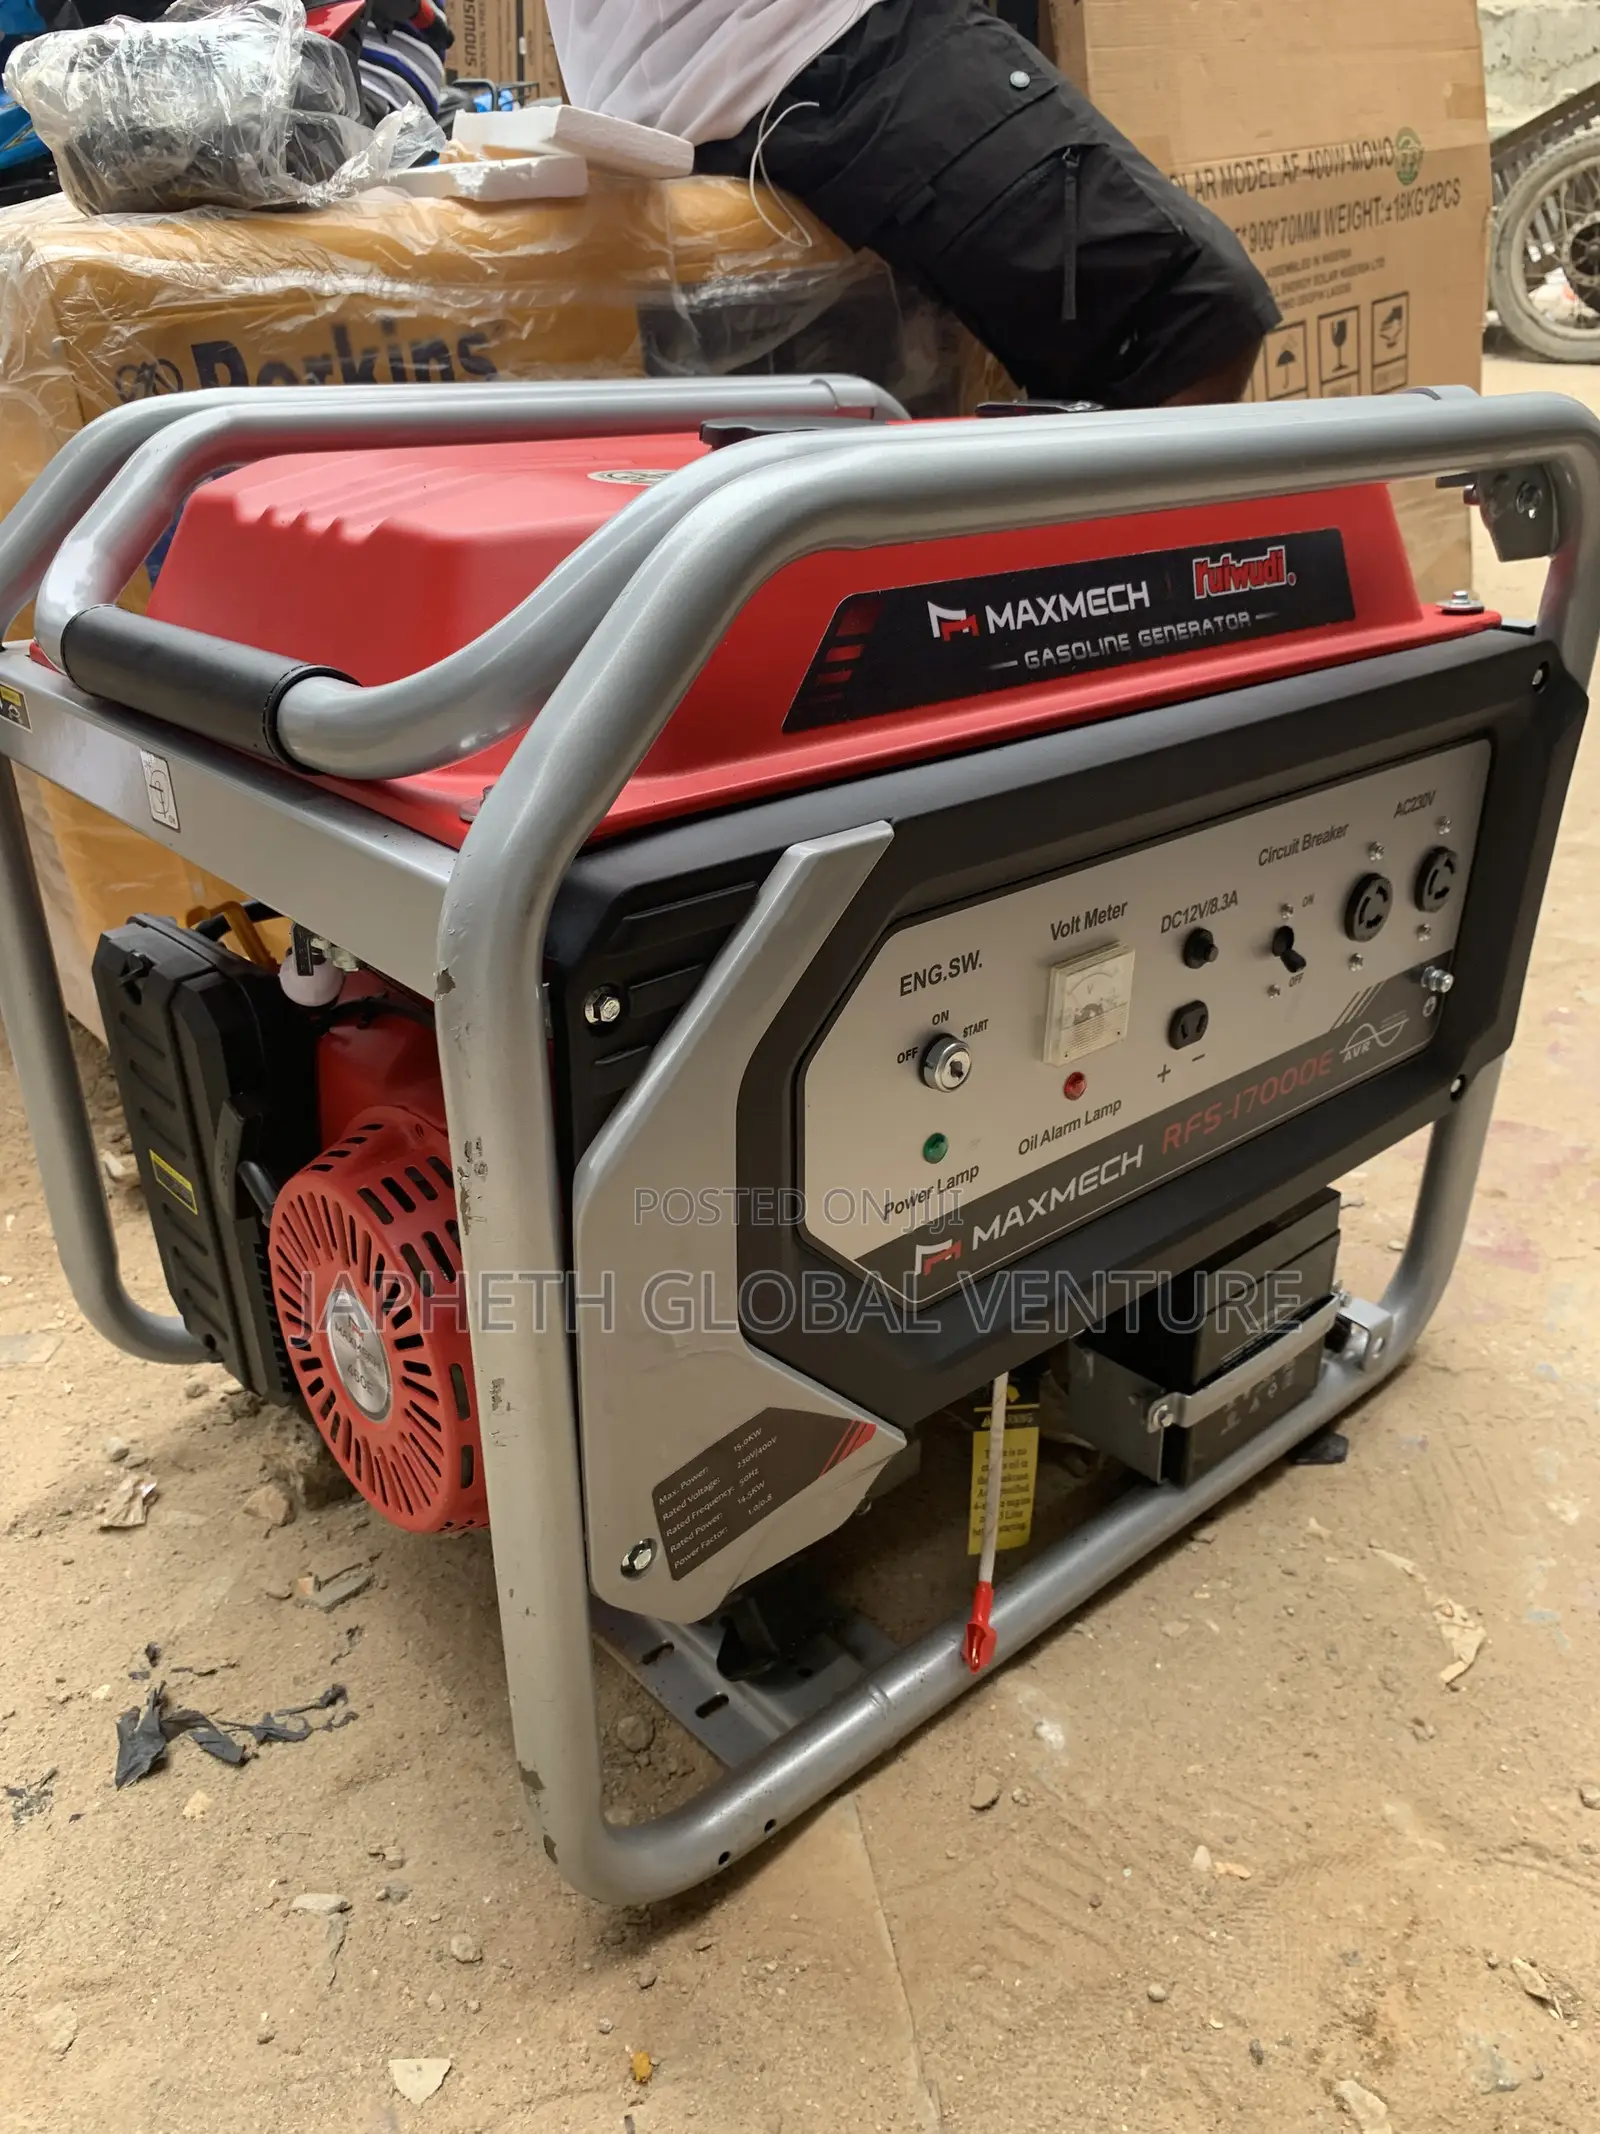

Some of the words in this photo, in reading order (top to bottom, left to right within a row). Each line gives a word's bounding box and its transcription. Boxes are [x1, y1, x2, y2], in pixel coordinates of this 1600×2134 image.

[985, 580, 1151, 634] MAXMECH
[1024, 634, 1132, 670] GASOLINE
[1138, 610, 1252, 648] GENERATOR
[1393, 790, 1437, 819] AC230V
[1258, 837, 1300, 867] Circuit
[1301, 823, 1350, 852] Breaker
[1050, 915, 1081, 941] Volt
[1084, 901, 1129, 930] Meter
[1160, 889, 1239, 934] DC12V/8.3A
[1301, 893, 1316, 908] ON
[899, 949, 984, 998] ENG.SW.
[1289, 972, 1304, 989] OFF
[931, 1010, 950, 1026] ON
[963, 1019, 989, 1039] START
[896, 1047, 919, 1065] OFF
[1341, 1041, 1372, 1063] AVR
[972, 1144, 1144, 1251] MAXMECH
[1162, 1049, 1335, 1155] RFS-17000E
[1018, 1133, 1038, 1156] Oil
[1040, 1117, 1082, 1147] Alarm
[1084, 1099, 1122, 1127] Lamp
[883, 1183, 935, 1222] Power
[936, 1164, 980, 1196] Lamp
[658, 1489, 680, 1506] Max.
[680, 1465, 709, 1490] Power:
[733, 1428, 763, 1453] 15.0KW
[662, 1501, 687, 1522] Rated
[687, 1477, 721, 1503] Voltage:
[736, 1436, 778, 1470] 230V/400V
[666, 1516, 691, 1537] Rated
[691, 1485, 736, 1520] Frequency:
[738, 1468, 760, 1487] 50Hz
[669, 1533, 695, 1554] Rated
[694, 1512, 724, 1537] Power:
[737, 1480, 766, 1505] 14.5KW
[673, 1547, 700, 1569] Power
[700, 1526, 729, 1549] Factor:
[747, 1494, 773, 1516] 1.0/0.8
